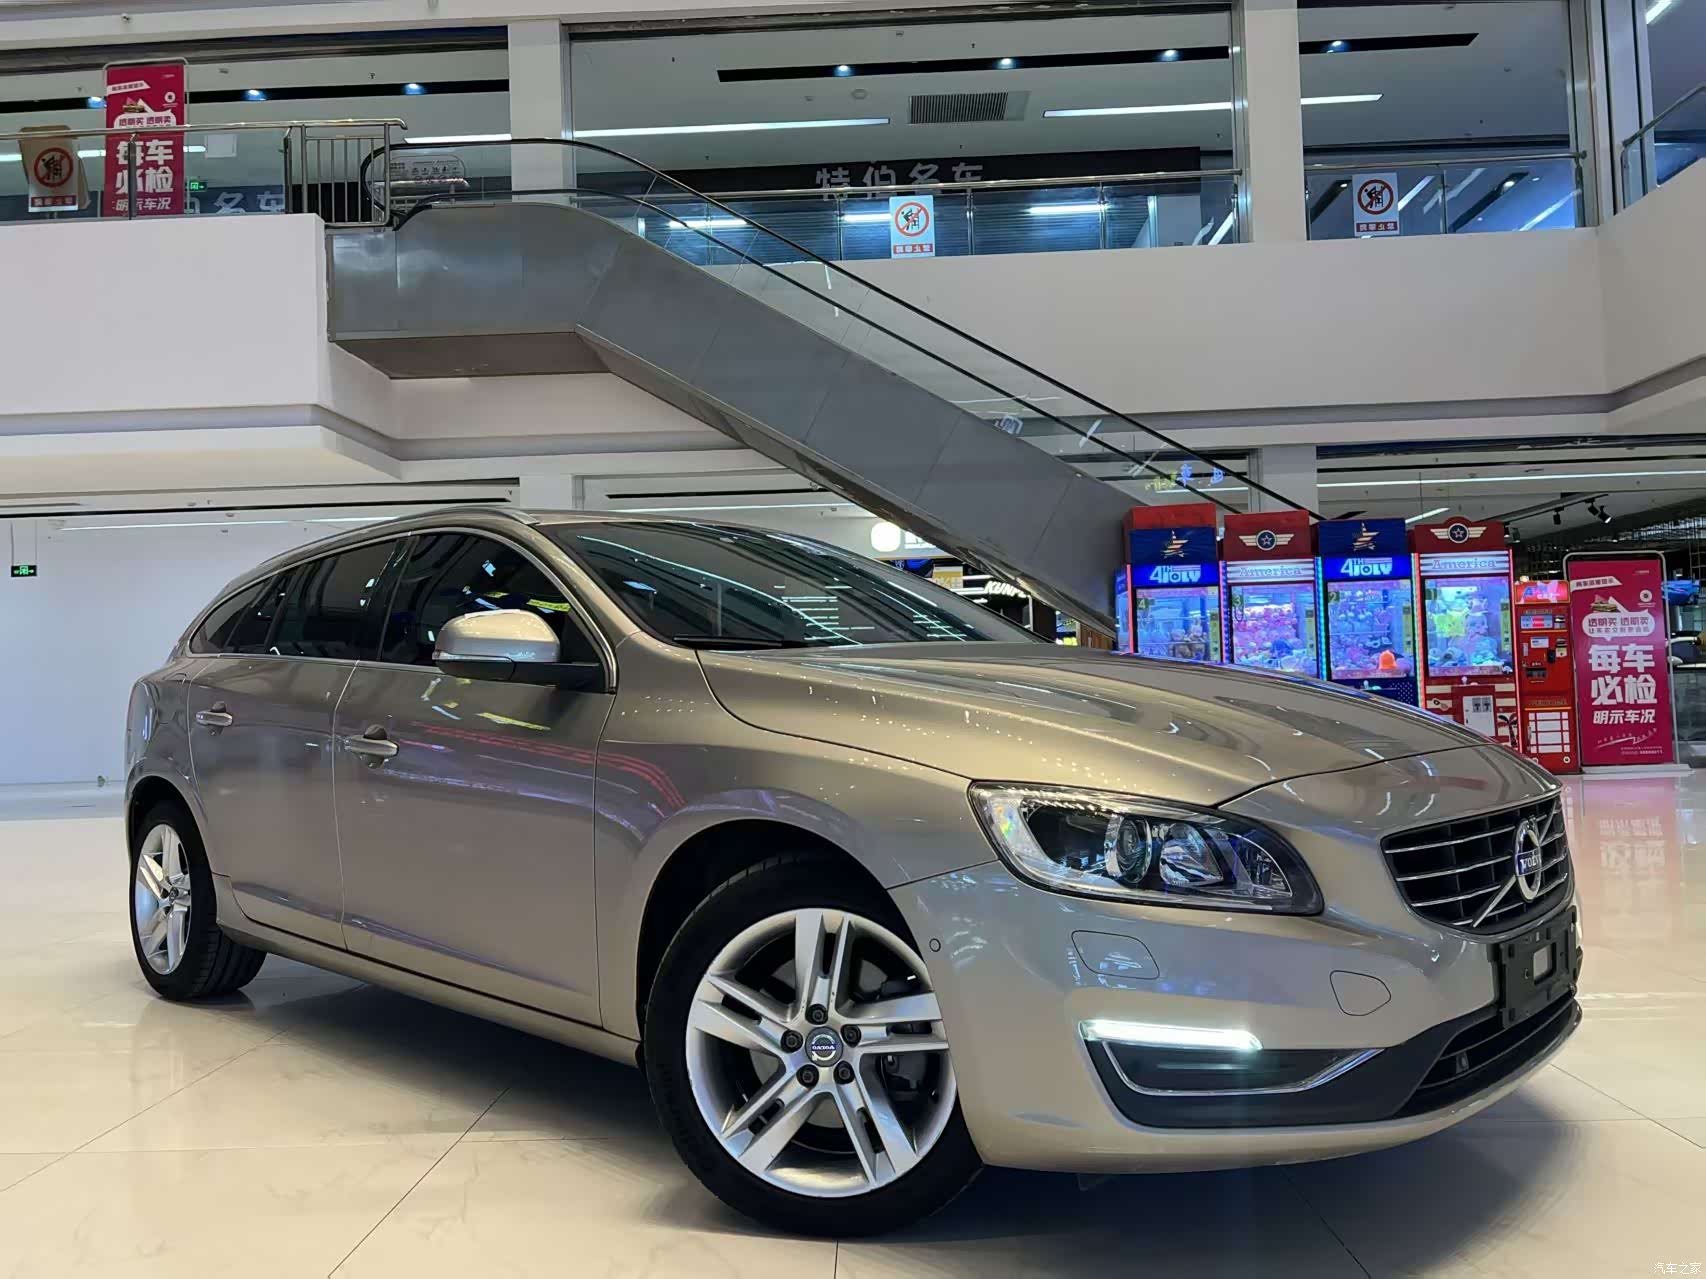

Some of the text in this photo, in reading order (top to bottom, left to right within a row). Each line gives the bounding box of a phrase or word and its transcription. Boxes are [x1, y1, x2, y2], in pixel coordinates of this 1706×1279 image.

[116, 139, 174, 166] 每车
[116, 166, 174, 195] 必检
[1239, 565, 1302, 577] America
[1432, 557, 1498, 570] America
[985, 580, 1027, 598] KUN
[1138, 598, 1146, 609] 4
[1233, 595, 1241, 607] 3
[1329, 592, 1337, 603] 2
[1589, 643, 1656, 673] 每车
[1591, 674, 1658, 706] 必检
[1593, 709, 1655, 724] 明示车况
